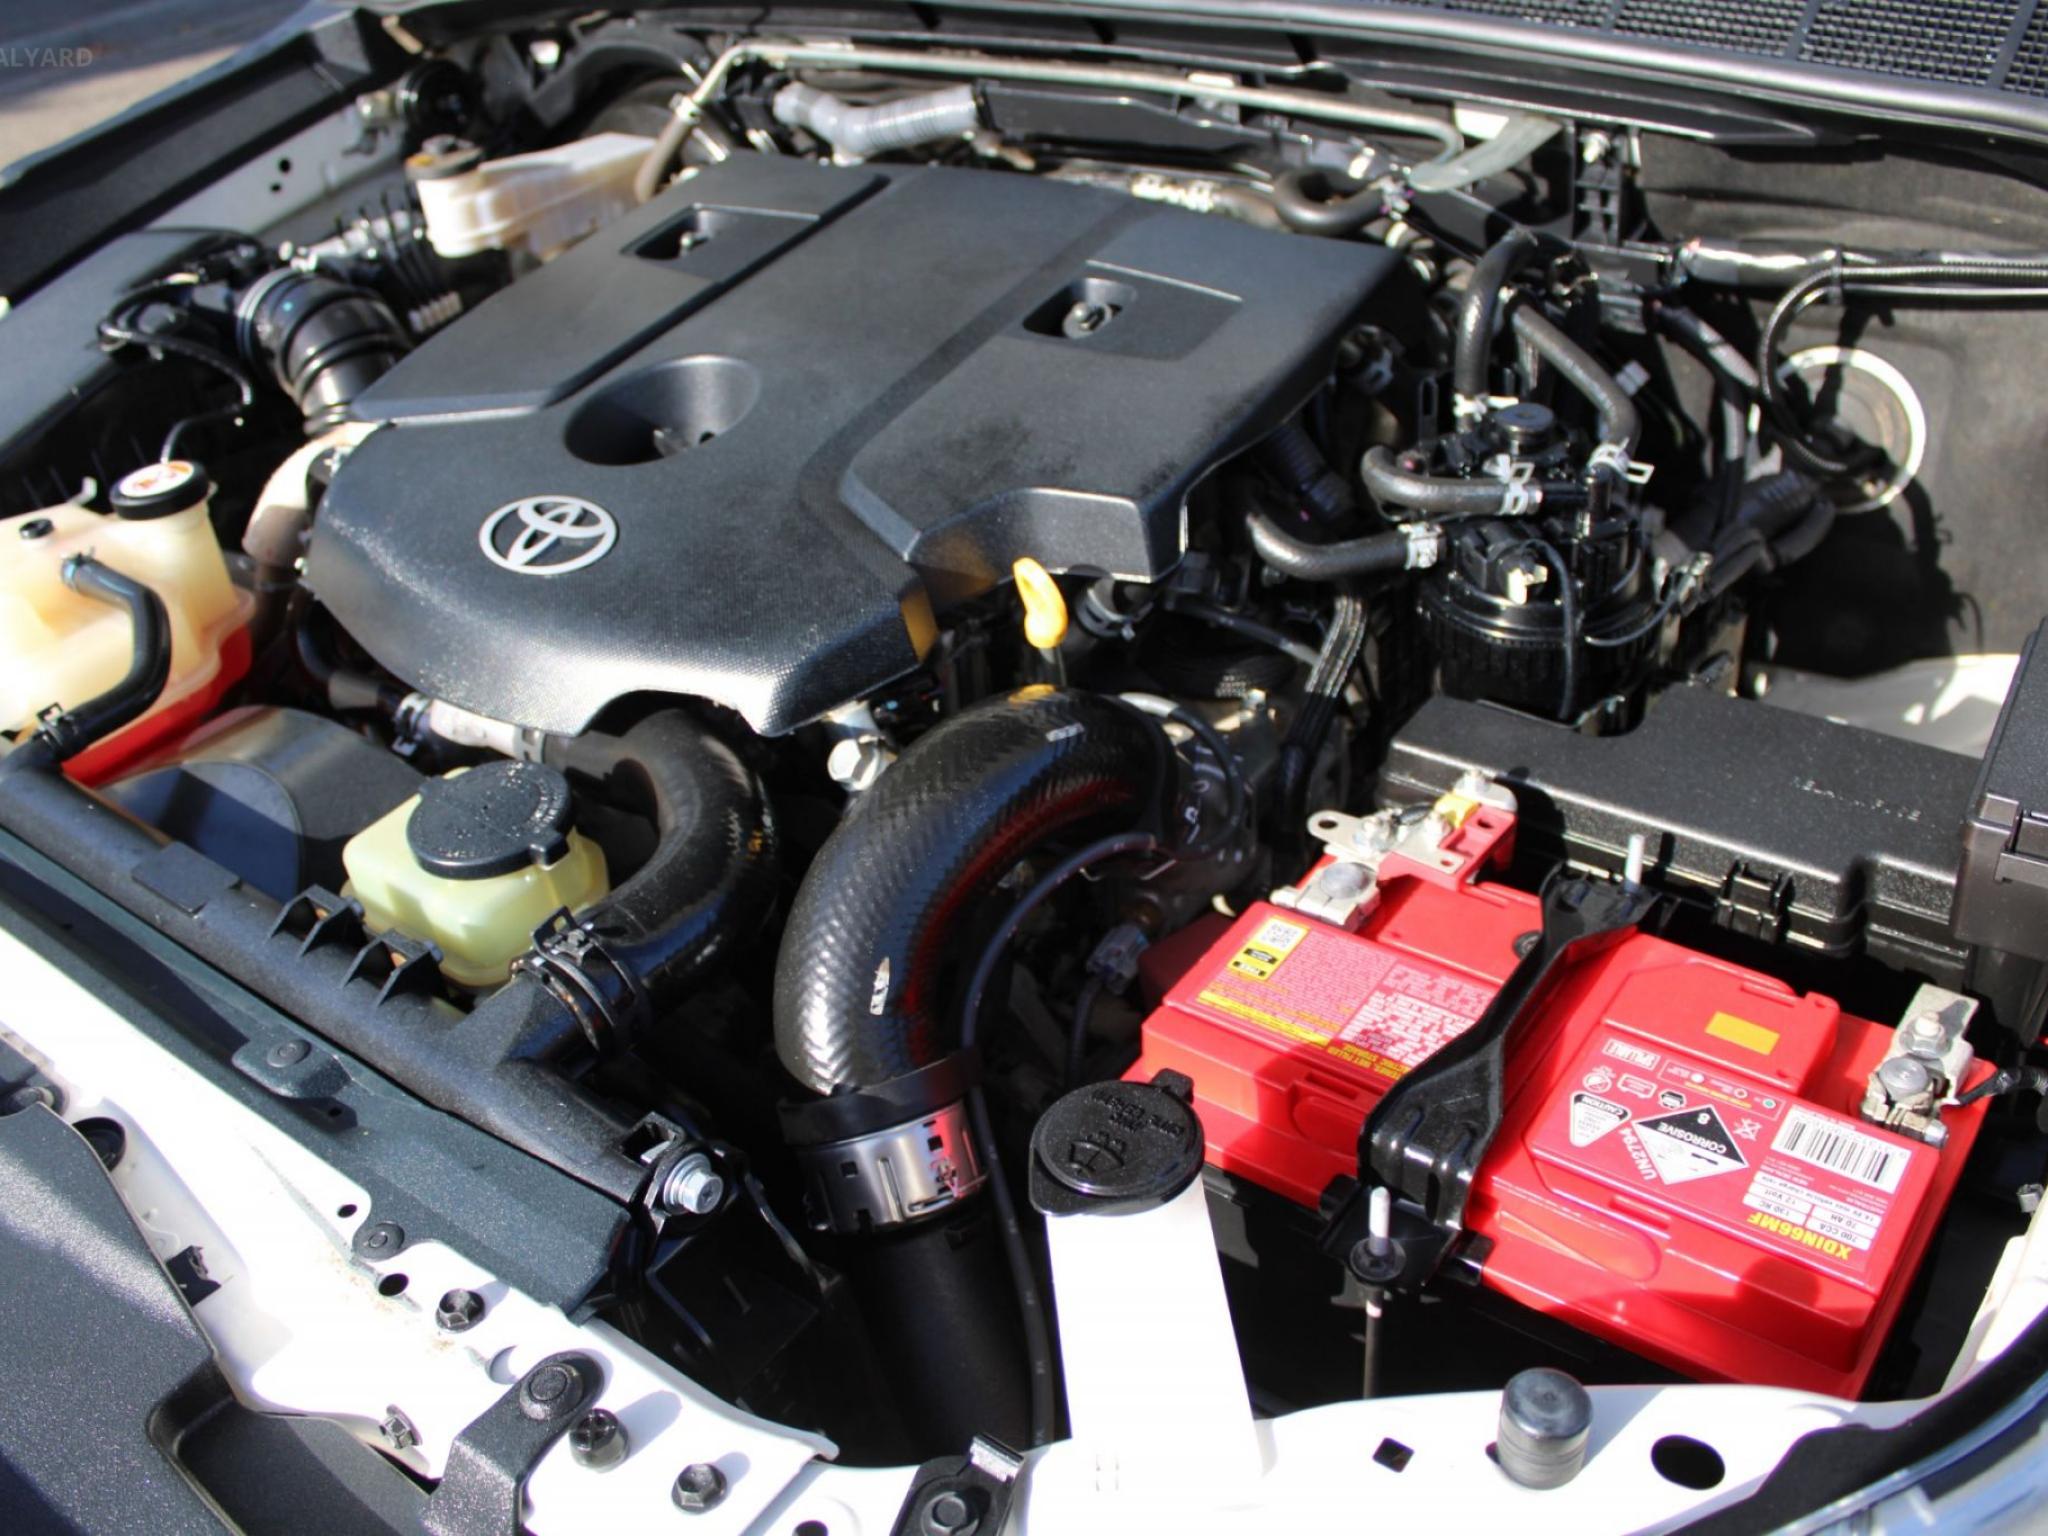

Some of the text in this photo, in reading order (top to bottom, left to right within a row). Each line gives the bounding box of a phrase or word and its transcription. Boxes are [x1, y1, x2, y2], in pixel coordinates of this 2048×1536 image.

[1581, 1095, 1624, 1116] CAUTION
[1697, 1112, 1711, 1125] 8
[1657, 1121, 1727, 1154] CORROSIVE
[1619, 1127, 1657, 1180] UN2794
[1747, 1211, 1852, 1260] XDIN66MF
[1819, 1223, 1839, 1235] CCA
